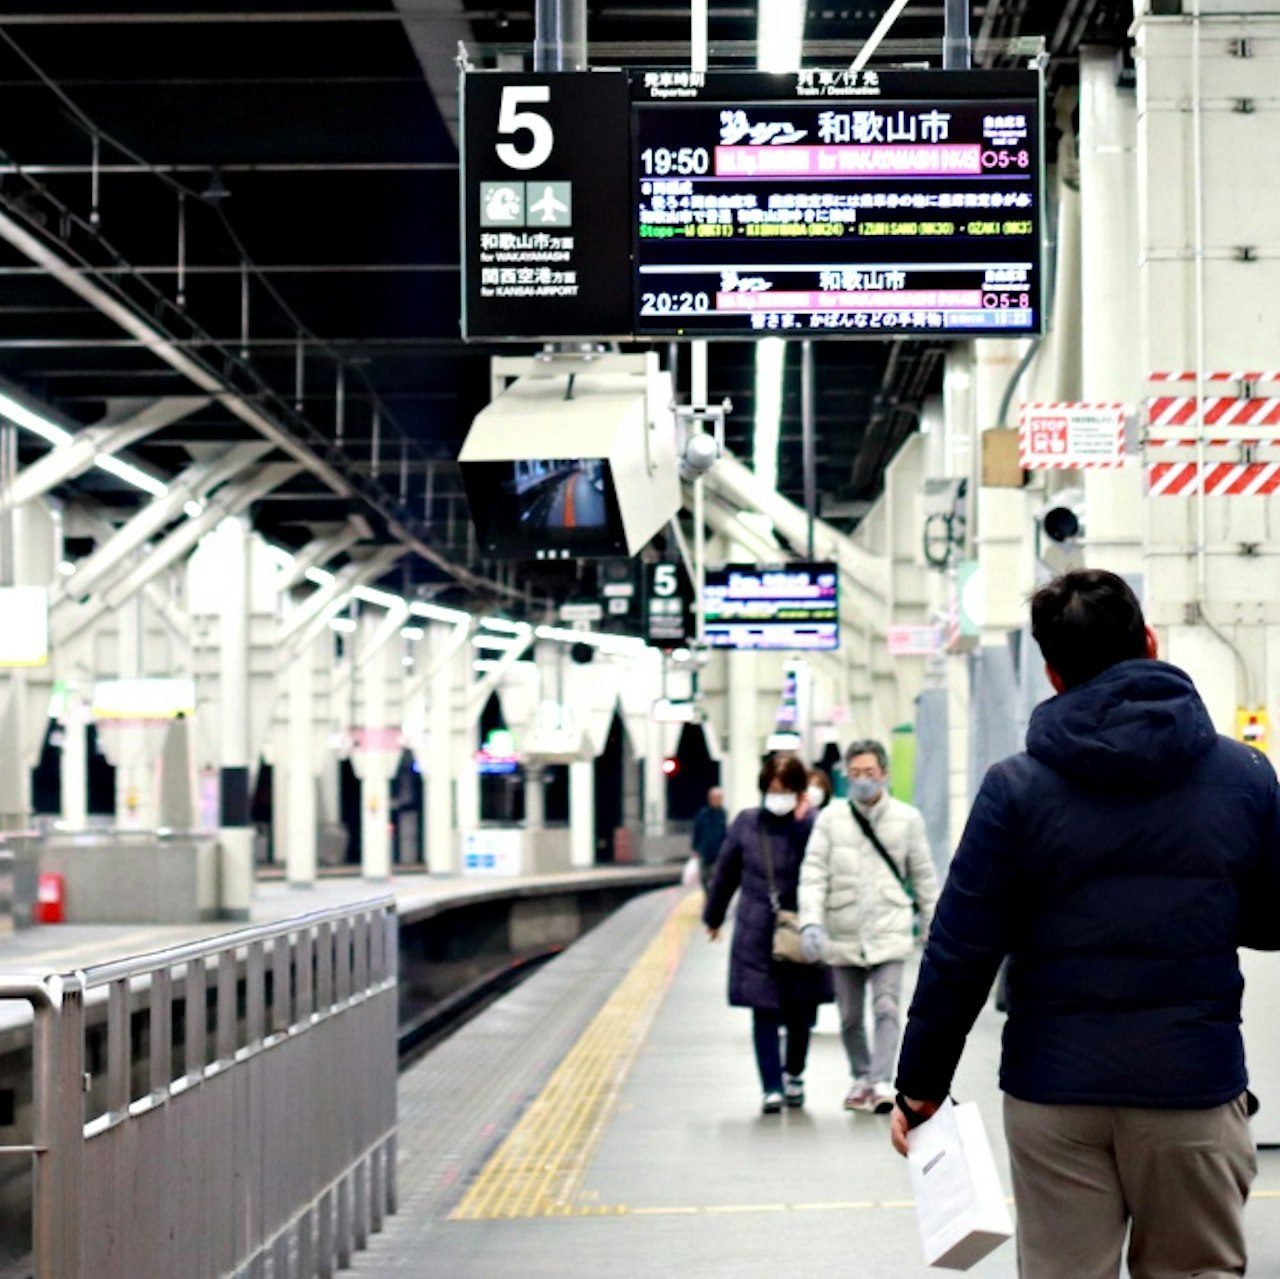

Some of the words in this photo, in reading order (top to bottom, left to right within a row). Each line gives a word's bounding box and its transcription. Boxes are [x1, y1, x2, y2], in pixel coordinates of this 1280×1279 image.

[495, 86, 554, 170] 5
[818, 109, 952, 144] 和歌山市
[640, 147, 710, 175] 19:50
[480, 232, 575, 250] 和歌山市方面
[819, 270, 906, 291] 和歌山市
[640, 292, 710, 314] 20:20
[653, 565, 678, 596] 5
